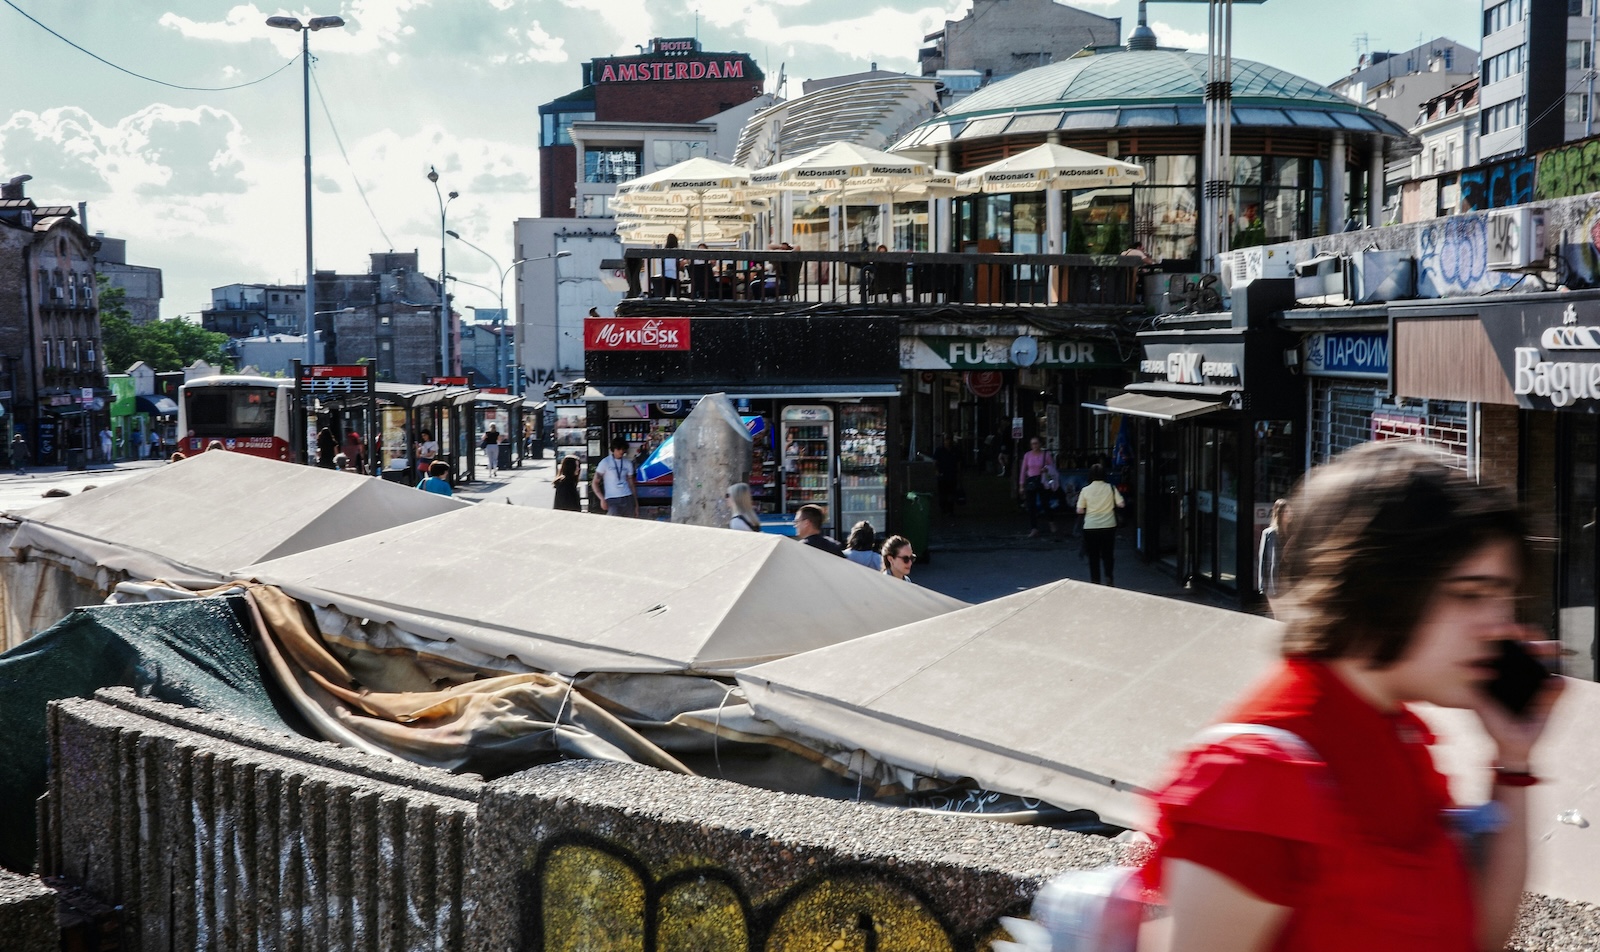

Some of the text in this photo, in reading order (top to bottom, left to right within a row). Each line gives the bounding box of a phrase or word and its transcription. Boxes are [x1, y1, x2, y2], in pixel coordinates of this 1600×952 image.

[661, 41, 692, 50] HOTEL
[601, 60, 744, 82] AMSTERDAM
[797, 169, 847, 177] McDonald's
[1059, 168, 1104, 177] McDonald's
[988, 173, 1035, 182] McDonald's
[671, 180, 717, 188] McDonald's
[595, 323, 625, 347] Moj
[1514, 346, 1600, 408] Bague
